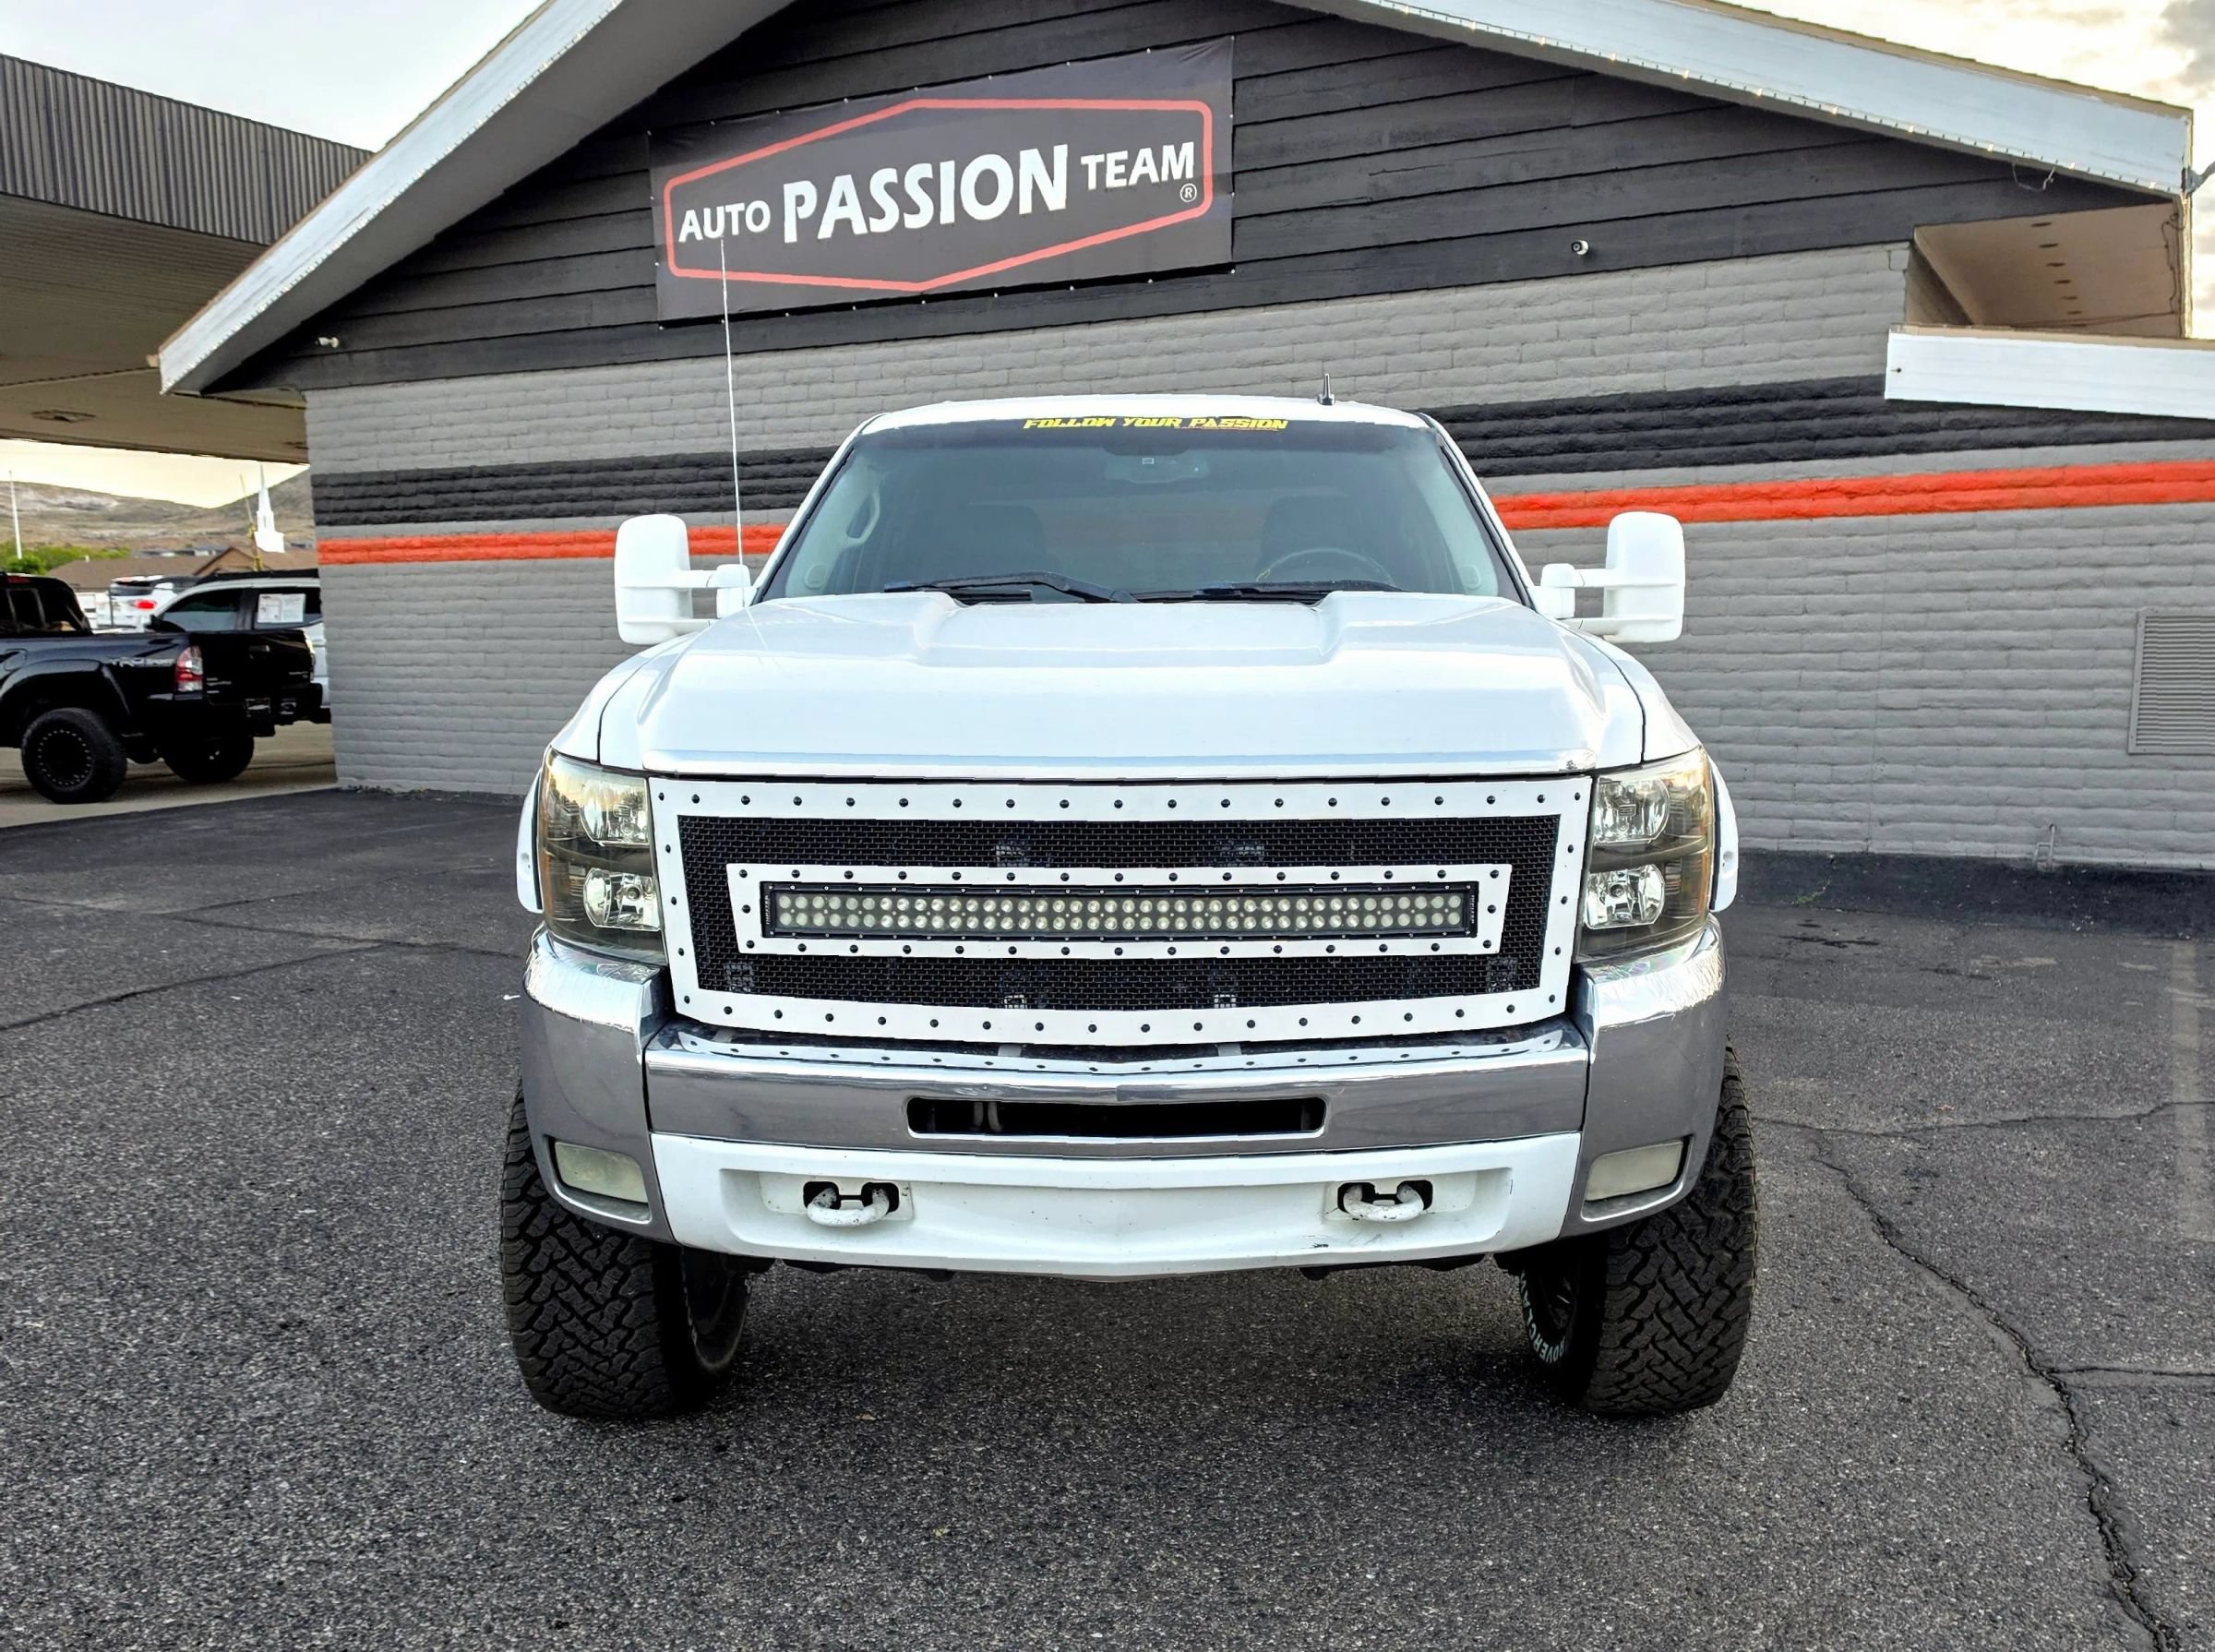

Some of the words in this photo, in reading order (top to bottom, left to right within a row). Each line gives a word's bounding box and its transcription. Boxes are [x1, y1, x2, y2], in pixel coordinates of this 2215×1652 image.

[678, 200, 772, 243] AUTO
[784, 144, 1069, 244] PASSION
[1080, 141, 1195, 191] TEAM
[1023, 417, 1117, 429] FOLLOW
[1121, 417, 1182, 428] YOUR
[1188, 417, 1288, 429] PASSION
